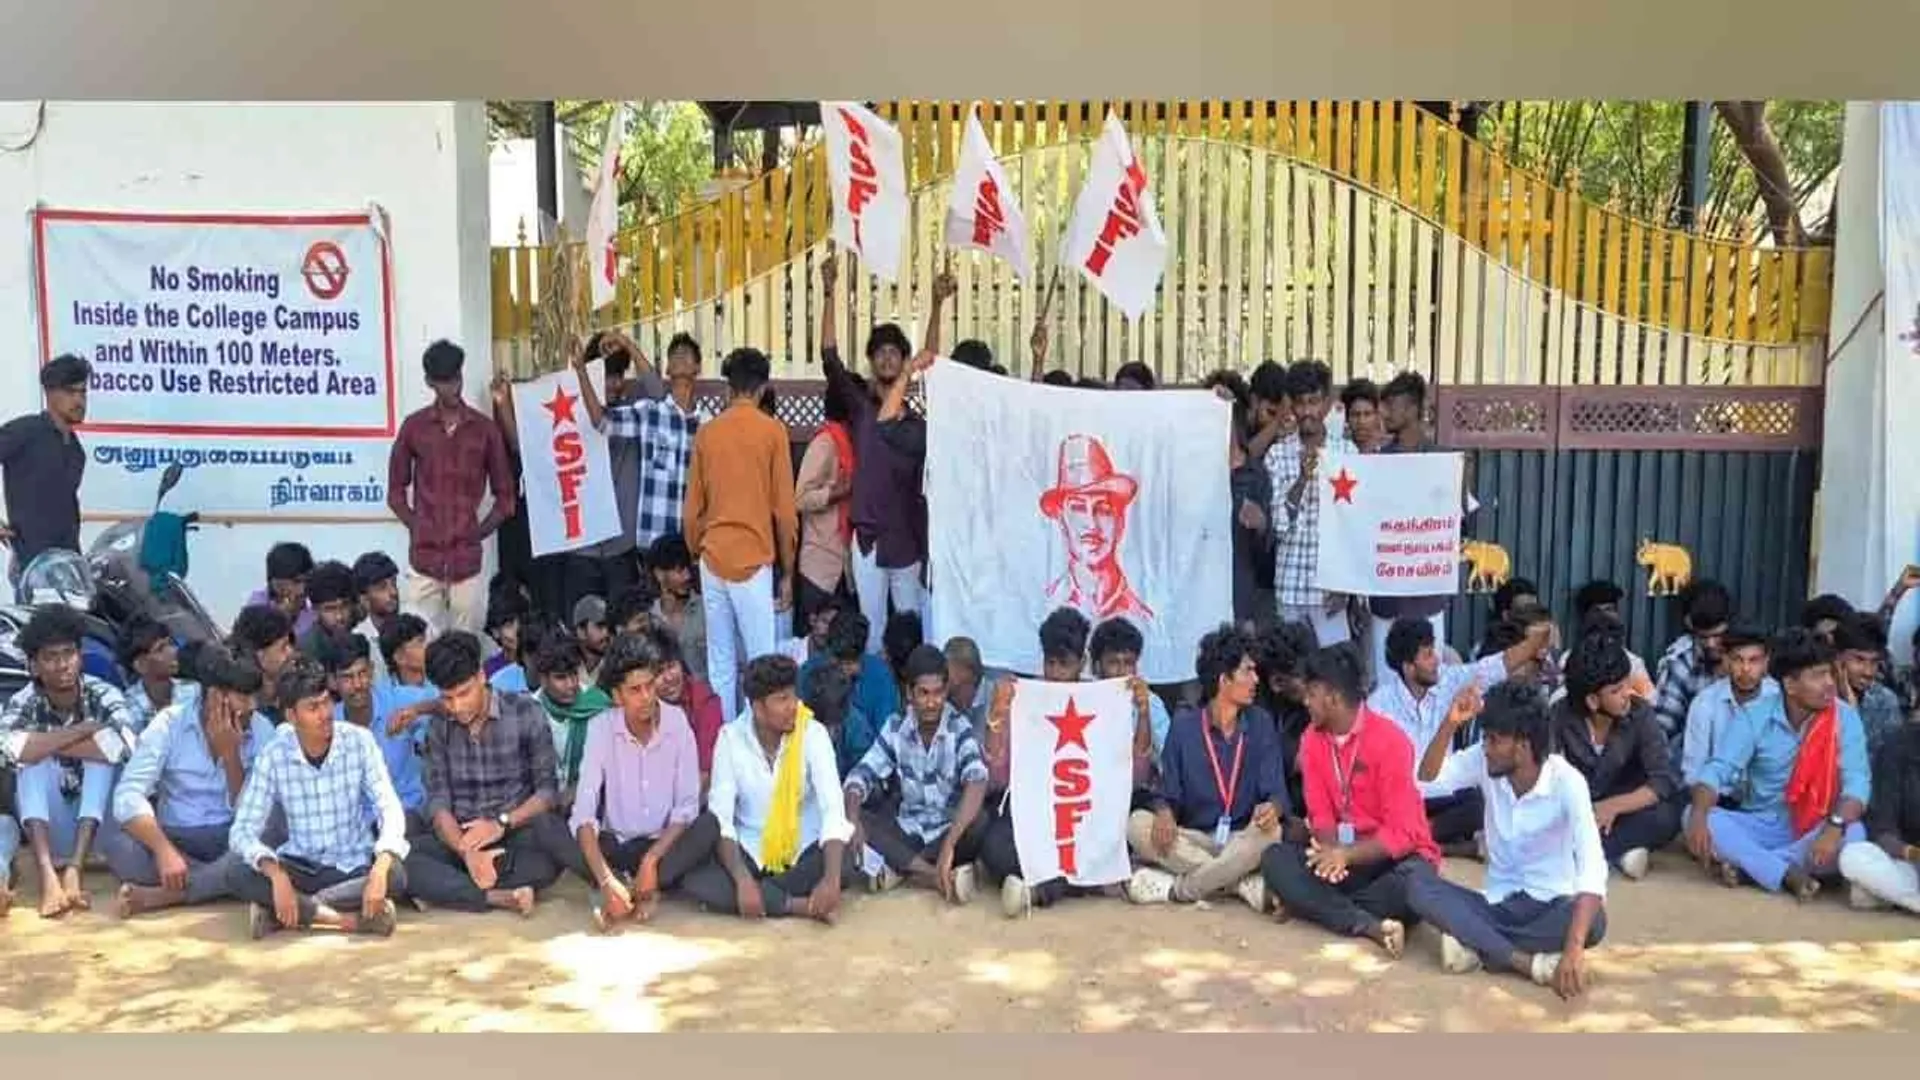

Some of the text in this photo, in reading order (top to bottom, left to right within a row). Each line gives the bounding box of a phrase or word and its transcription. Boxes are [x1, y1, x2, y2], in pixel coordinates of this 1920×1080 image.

[1085, 182, 1140, 277] SFI
[150, 264, 279, 299] No Smoking
[73, 300, 361, 337] Inside the College Campus
[96, 338, 341, 367] and Within 100 Meters.
[89, 368, 377, 395] bacco Use Restricted Area
[553, 431, 587, 541] SFI
[1053, 757, 1092, 877] SFI
